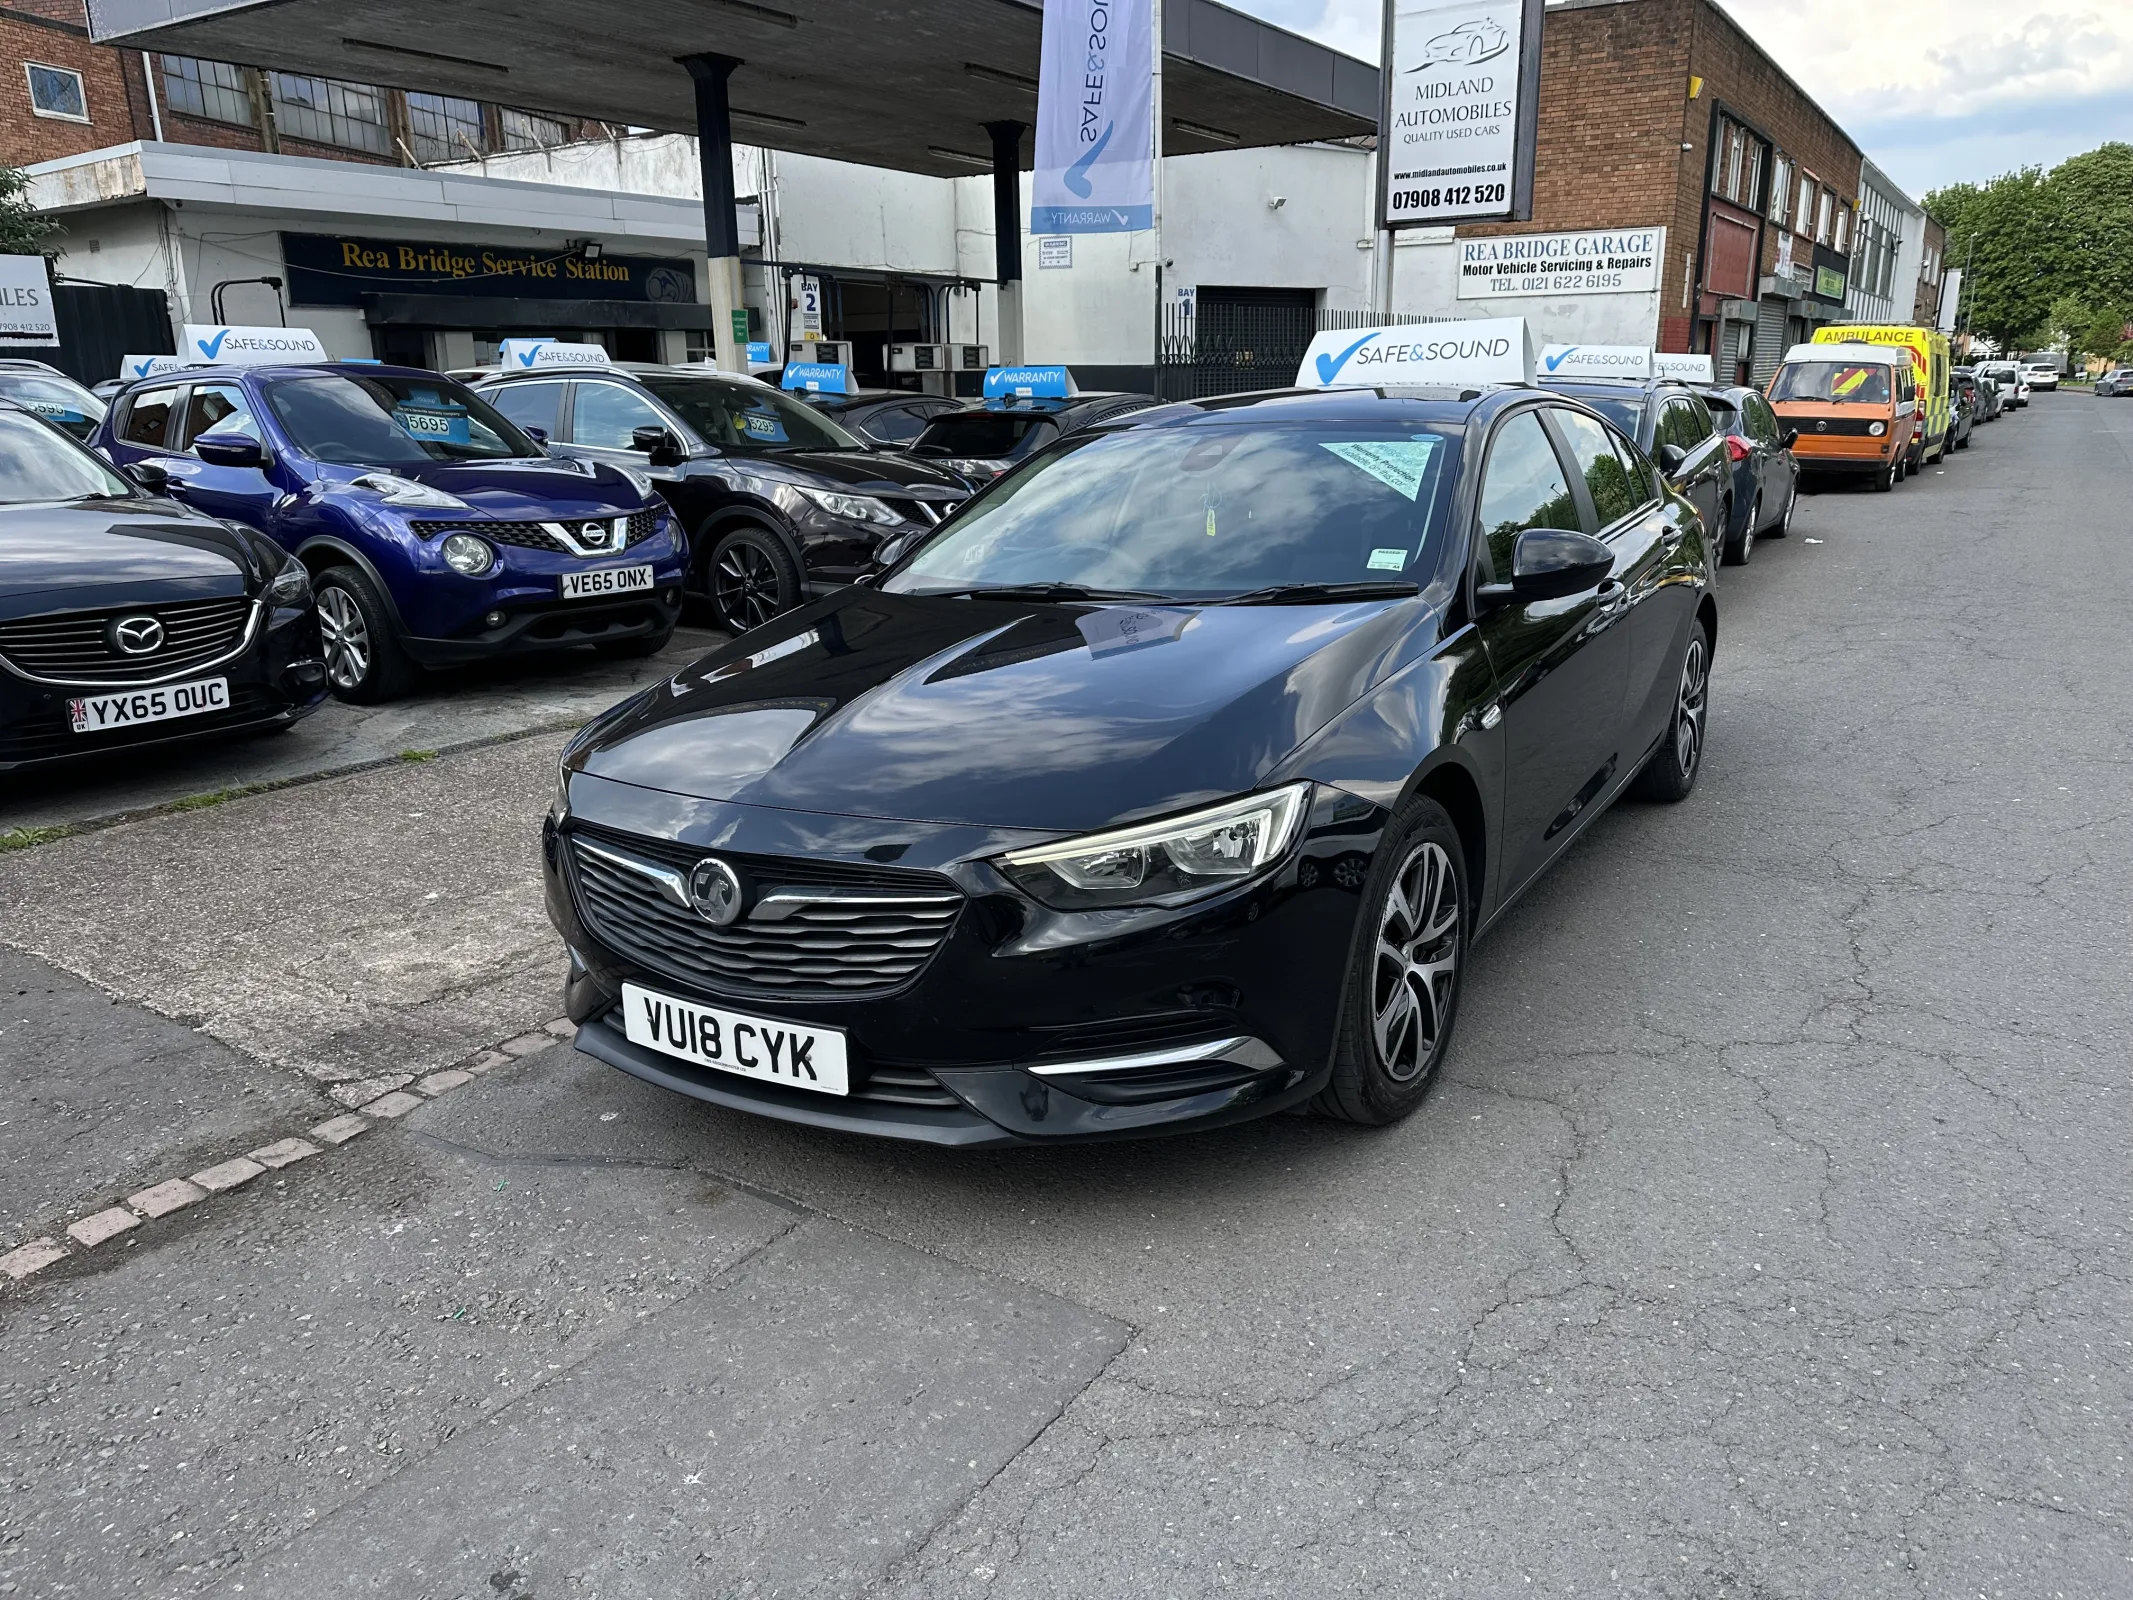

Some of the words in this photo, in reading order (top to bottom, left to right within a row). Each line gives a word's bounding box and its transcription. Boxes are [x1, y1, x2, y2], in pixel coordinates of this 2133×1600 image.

[1416, 77, 1494, 100] MIDLAND
[1395, 100, 1512, 128] AUTOMOBILES
[1403, 130, 1444, 144] QUALITY
[1446, 128, 1472, 139] USED
[1475, 125, 1500, 136] CARS
[1394, 162, 1507, 180] www.midlandautomobiles.co.uk
[1393, 189, 1440, 209] 07908
[1444, 186, 1471, 205] 412
[1475, 183, 1505, 203] 520
[1464, 244, 1498, 261] REA
[1503, 239, 1570, 259] BRIDGE
[1574, 234, 1653, 255] GARAGE
[340, 242, 391, 268] Rea
[396, 246, 476, 279] Bridge
[482, 251, 557, 278] Service
[565, 257, 629, 281] Station
[1463, 264, 1493, 276] Motor
[1496, 262, 1537, 274] Vehicle
[1540, 259, 1592, 272] Servicing
[1596, 260, 1604, 270] &
[1607, 256, 1652, 270] Repairs
[801, 282, 818, 292] BAY
[1490, 278, 1518, 291] TEL.
[1522, 276, 1548, 290] 0121
[1553, 275, 1582, 289] 622
[1586, 273, 1622, 288] 6195
[1178, 288, 1195, 297] BAY
[805, 293, 816, 311] 2
[1182, 298, 1190, 316] 1
[20, 323, 33, 332] 412
[35, 323, 51, 332] 520
[224, 338, 315, 352] SAFE&SOUND
[1823, 331, 1914, 343] AMBULANCE
[537, 351, 605, 363] SAFE&SOUND
[1356, 338, 1510, 365] SAFE&SOUND
[1566, 354, 1644, 366] SAFE&SOUND
[799, 367, 842, 379] WARRANTY
[1003, 371, 1060, 383] WARRANTY
[409, 415, 449, 432] 5695
[1351, 443, 1380, 461] Warranty
[1380, 460, 1416, 482] Protection
[570, 572, 613, 594] VE65
[617, 568, 647, 588] ONX
[91, 692, 167, 724] YX65
[174, 682, 224, 712] OUC
[643, 997, 722, 1059] VU18
[733, 1023, 818, 1081] CYK
